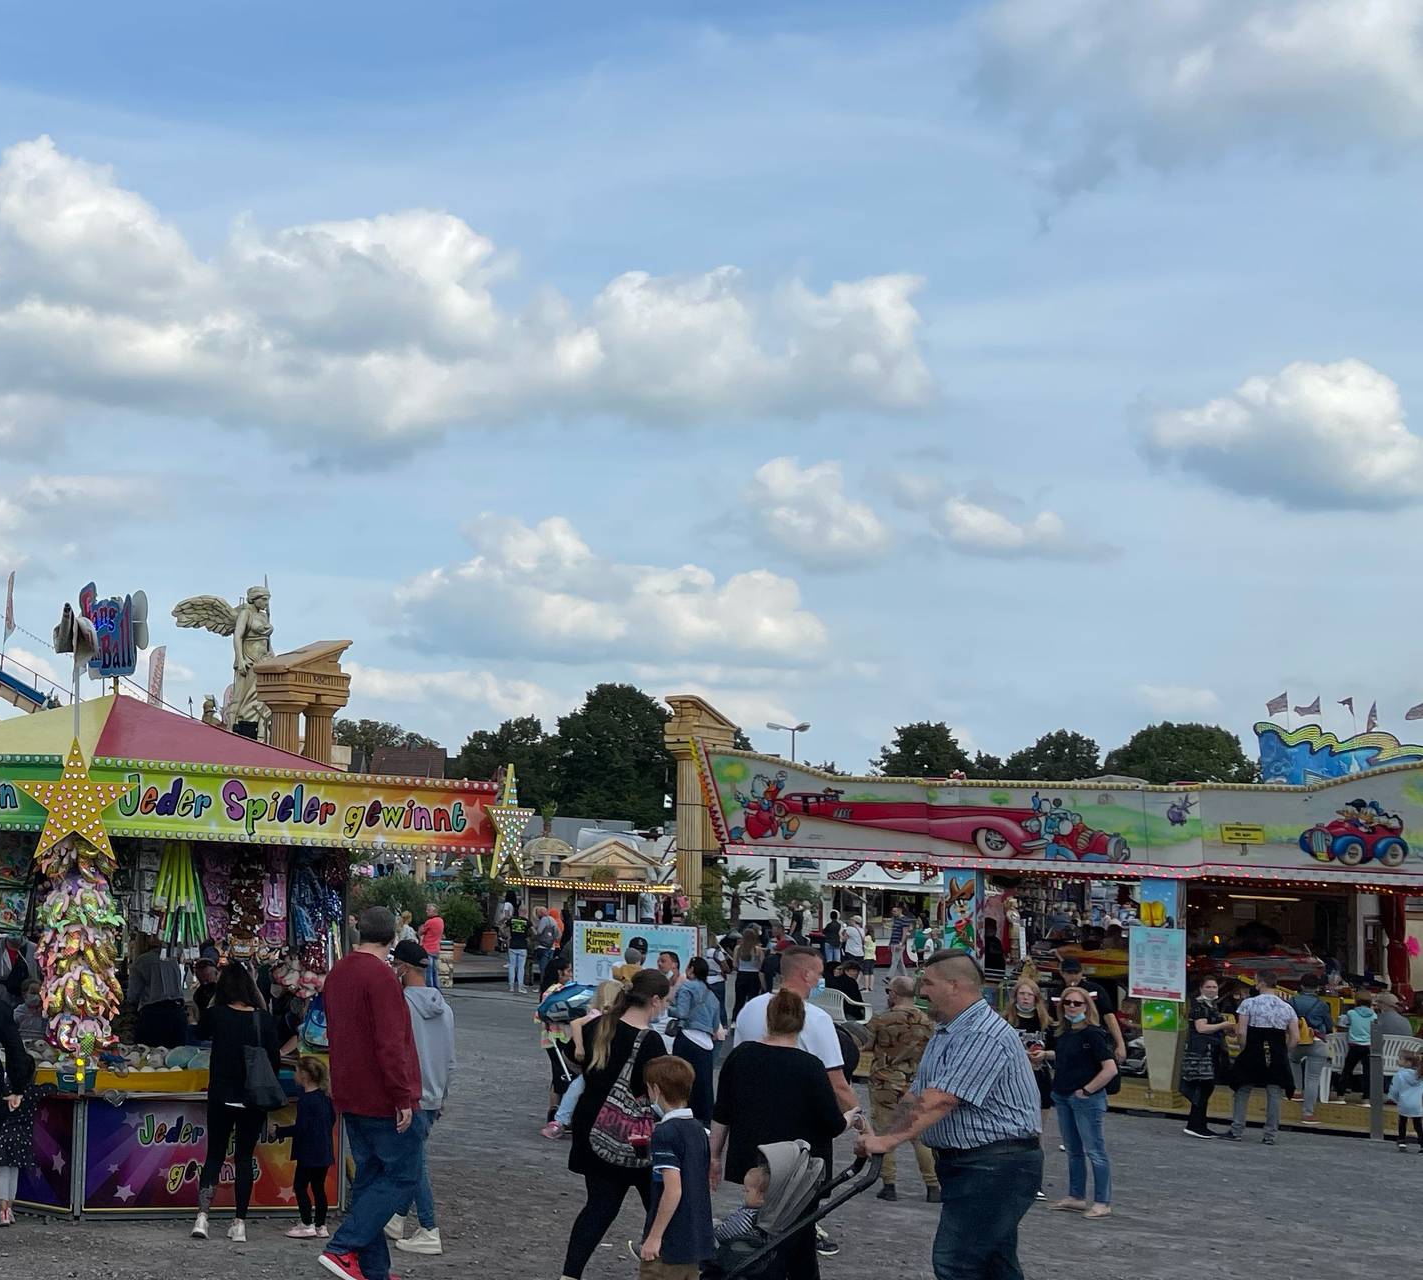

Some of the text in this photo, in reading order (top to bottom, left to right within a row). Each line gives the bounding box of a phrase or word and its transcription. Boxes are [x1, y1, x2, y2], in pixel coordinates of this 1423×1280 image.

[100, 604, 133, 669] Ball
[118, 773, 467, 839] Jeder Spieler gewinnt
[586, 929, 620, 939] Hammer
[586, 937, 615, 947] Kirmes
[586, 945, 604, 954] Park
[139, 1114, 204, 1145] Jeder
